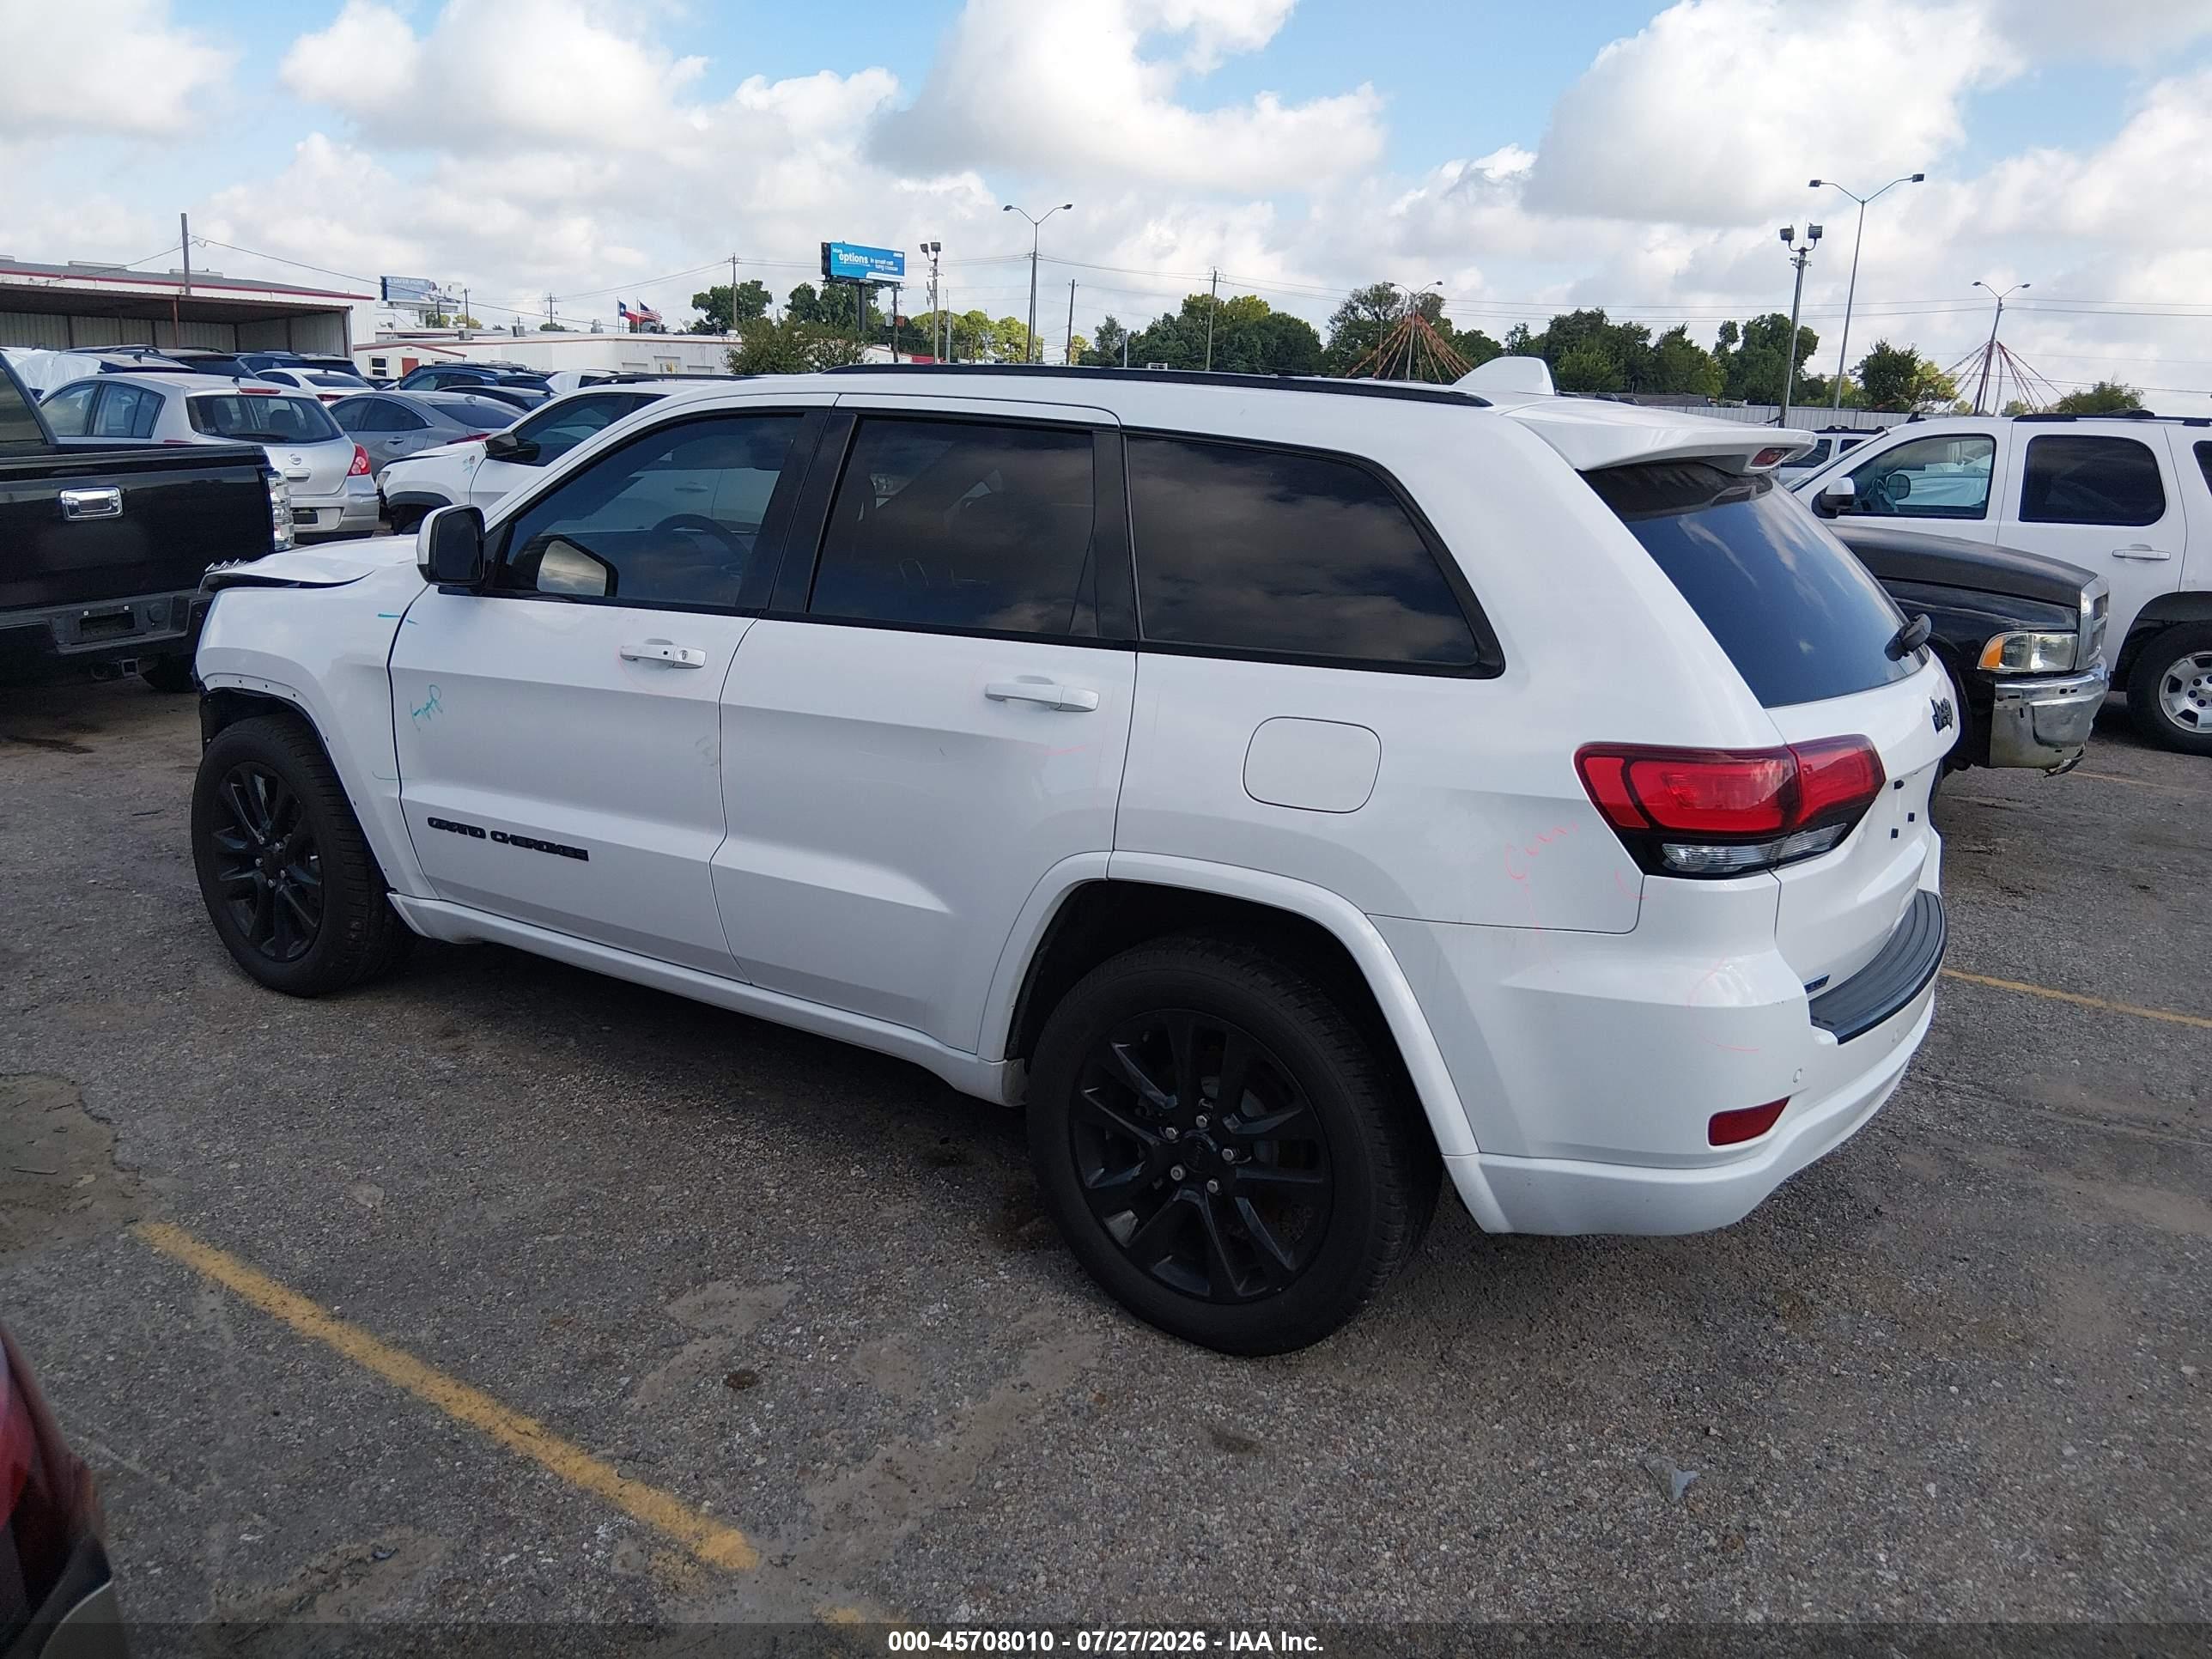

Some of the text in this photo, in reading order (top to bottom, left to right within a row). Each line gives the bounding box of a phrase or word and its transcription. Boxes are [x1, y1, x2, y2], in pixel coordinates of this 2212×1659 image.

[838, 252, 869, 264] options
[427, 817, 590, 861] GRAND CHEROKEE
